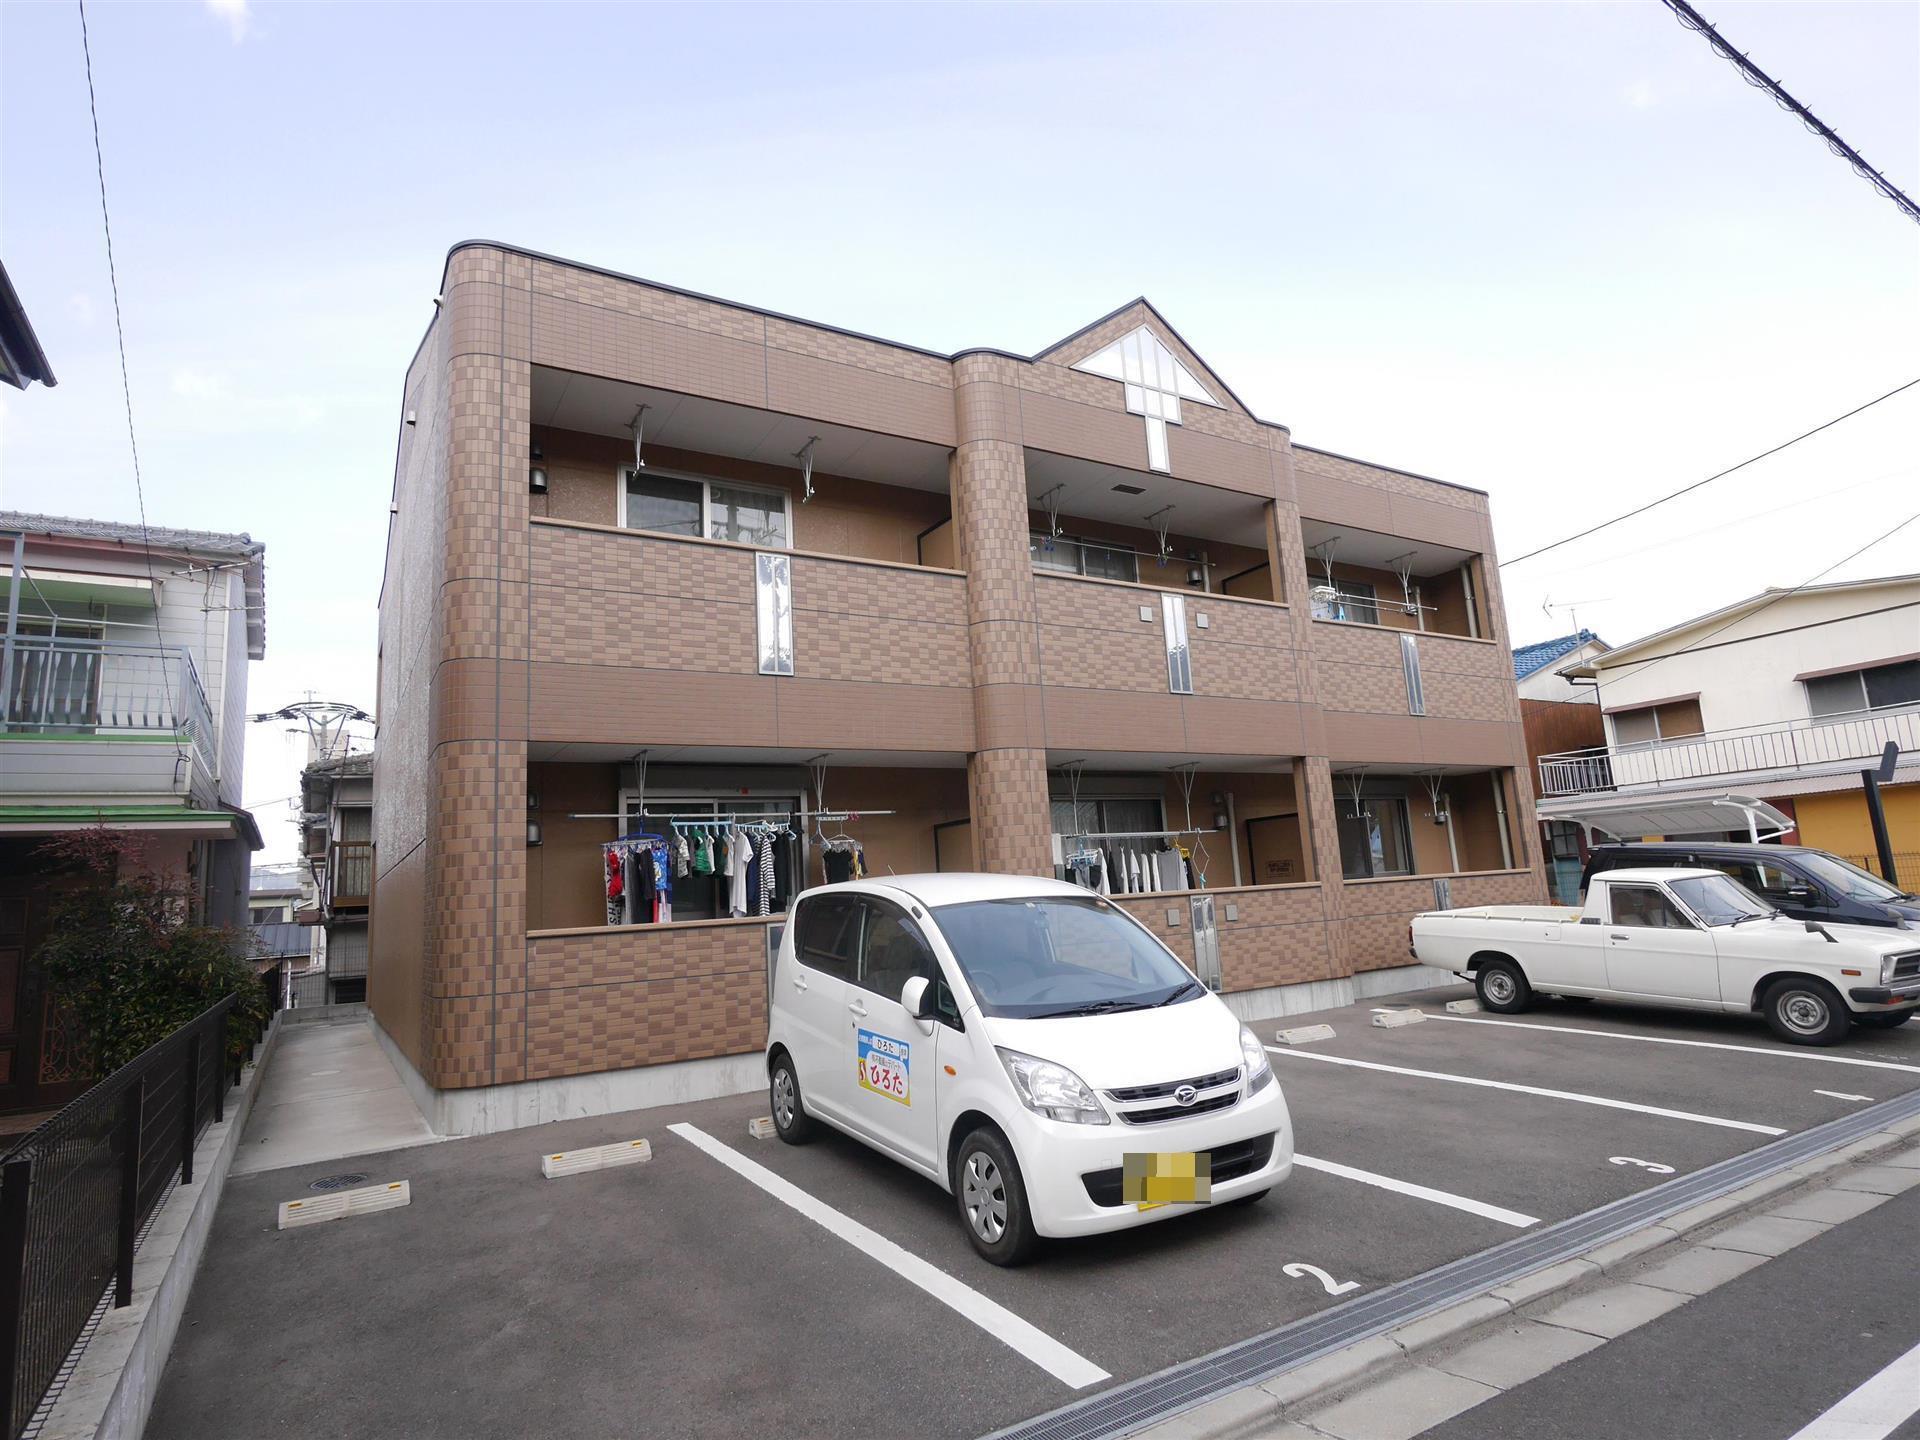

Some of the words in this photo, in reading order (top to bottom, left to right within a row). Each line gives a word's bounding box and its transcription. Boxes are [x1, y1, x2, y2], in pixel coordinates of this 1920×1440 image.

[877, 1039, 894, 1054] ひろた
[870, 1064, 903, 1095] ひろた
[1609, 1156, 1676, 1173] 3
[1282, 1263, 1361, 1296] 2
